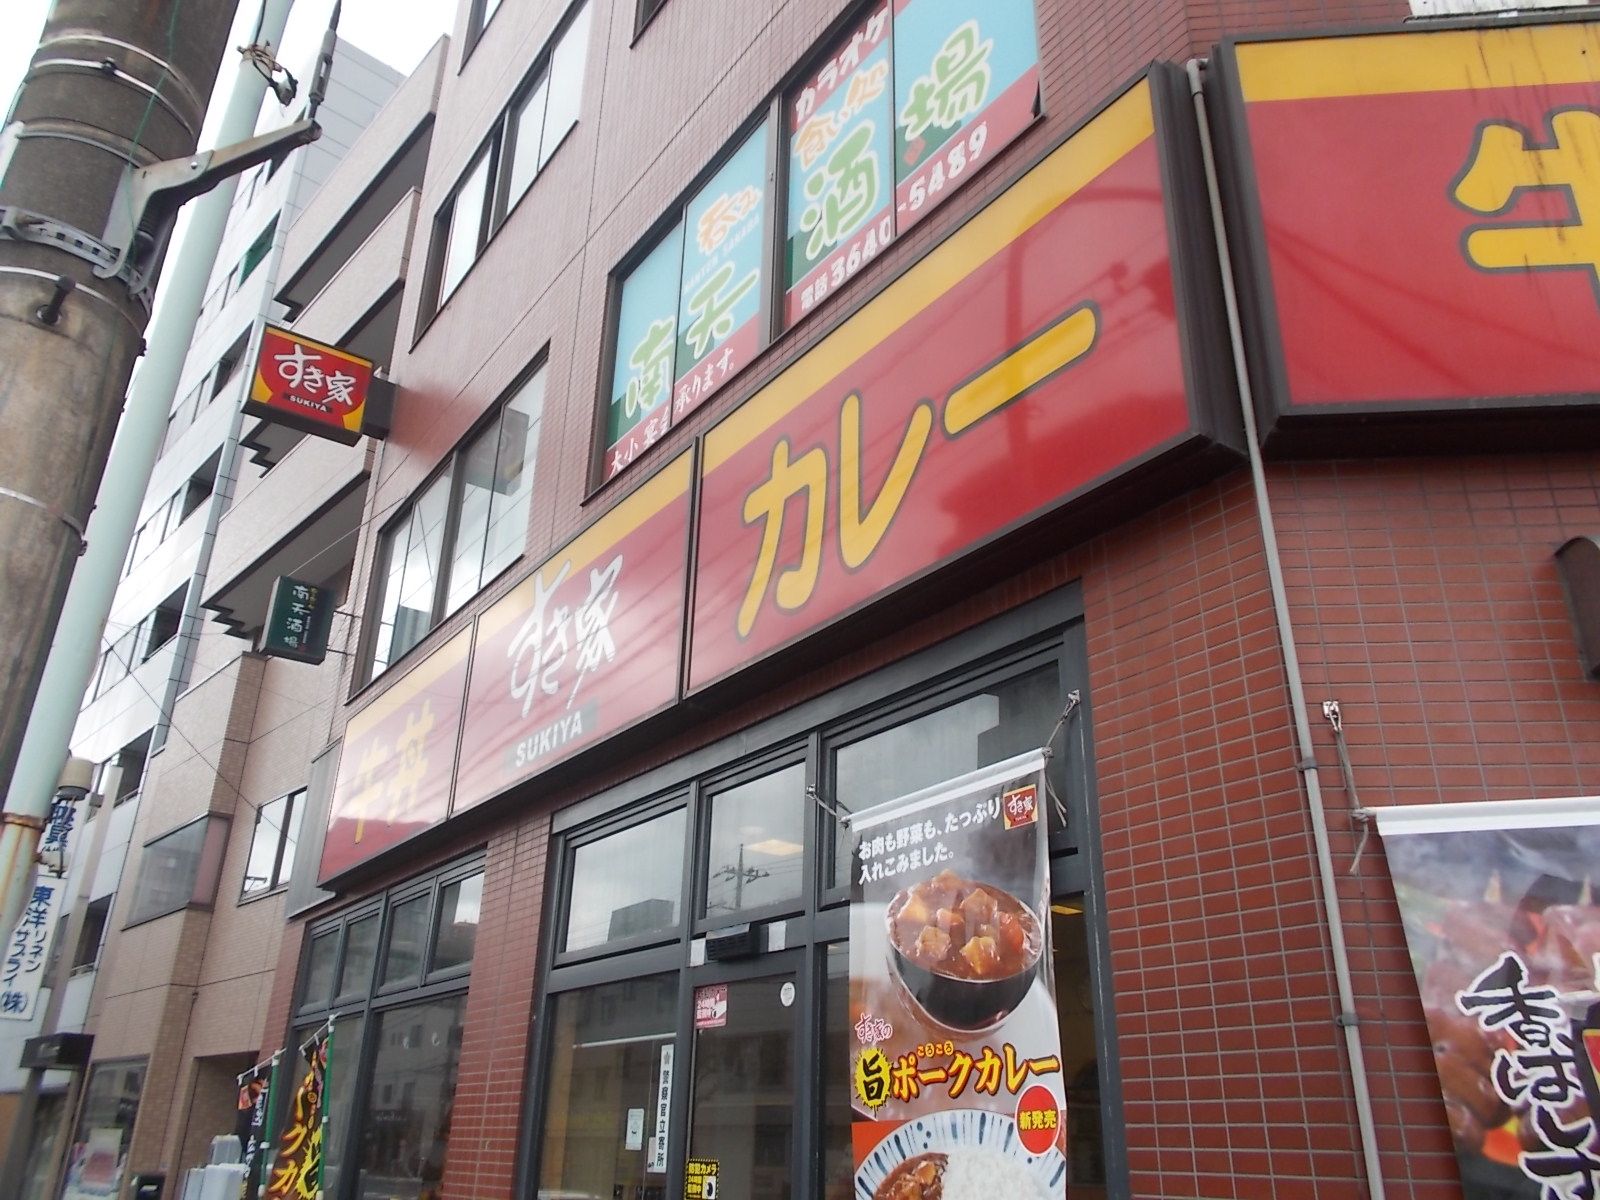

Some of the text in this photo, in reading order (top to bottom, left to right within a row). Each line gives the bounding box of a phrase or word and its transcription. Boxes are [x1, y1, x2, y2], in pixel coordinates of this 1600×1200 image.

[273, 343, 357, 407] すき家
[289, 395, 328, 413] SUKIYA
[734, 299, 1101, 643] カレー
[507, 553, 624, 719] すき家
[515, 710, 584, 768] SUKIYA
[348, 697, 437, 845] 牛丼
[858, 796, 1001, 861] お肉も野菜も、たっぷり
[1008, 793, 1034, 816] すき家
[858, 842, 955, 886] 入れこみました。
[25, 886, 55, 929] 東洋
[916, 1040, 955, 1058] ころころ
[1018, 1108, 1057, 1131] 新発売
